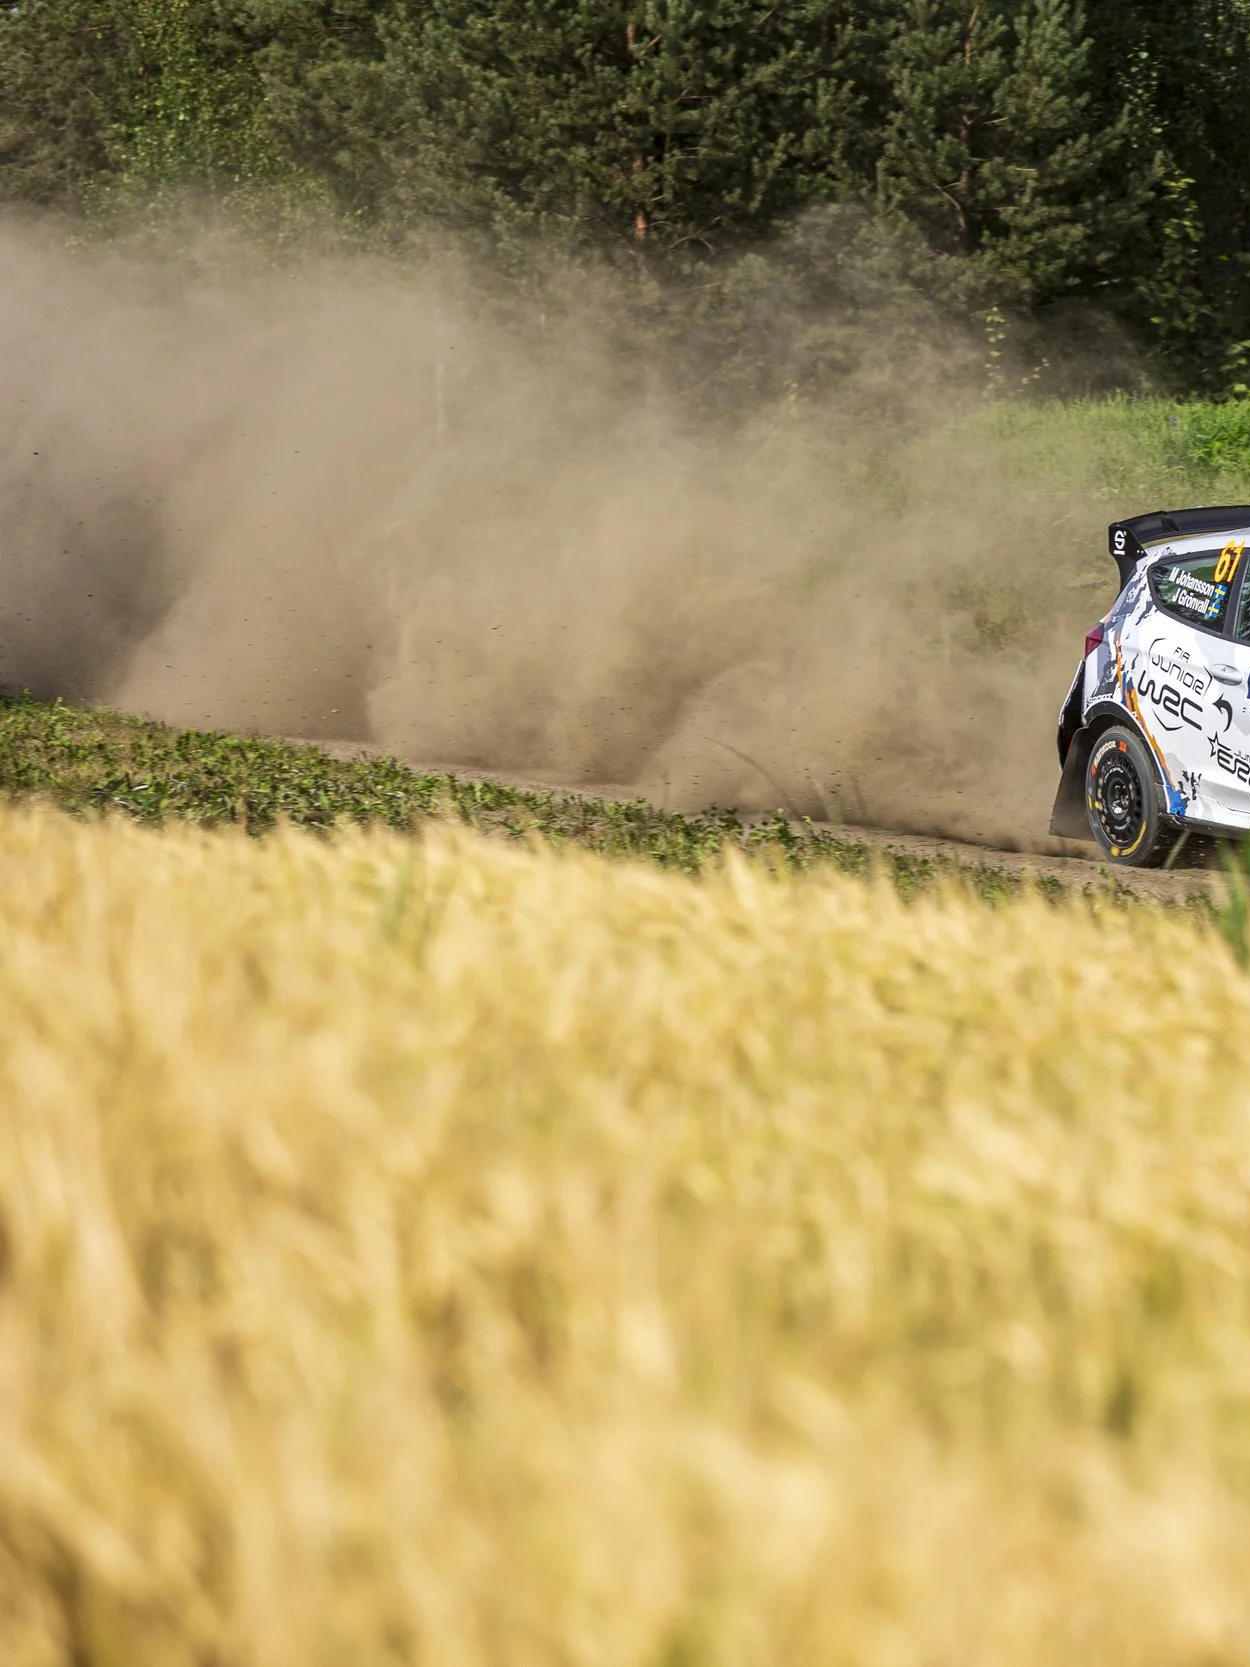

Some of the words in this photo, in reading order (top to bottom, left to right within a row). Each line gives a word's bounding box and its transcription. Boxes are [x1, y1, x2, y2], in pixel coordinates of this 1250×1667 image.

[1214, 541, 1246, 583] 61
[1168, 566, 1180, 583] M
[1176, 570, 1216, 598] Johansson
[1172, 588, 1182, 603] J
[1178, 590, 1211, 615] Grönvall
[1173, 646, 1191, 664] FIA
[1151, 654, 1205, 696] JUNIOR
[1137, 669, 1203, 731] WRC
